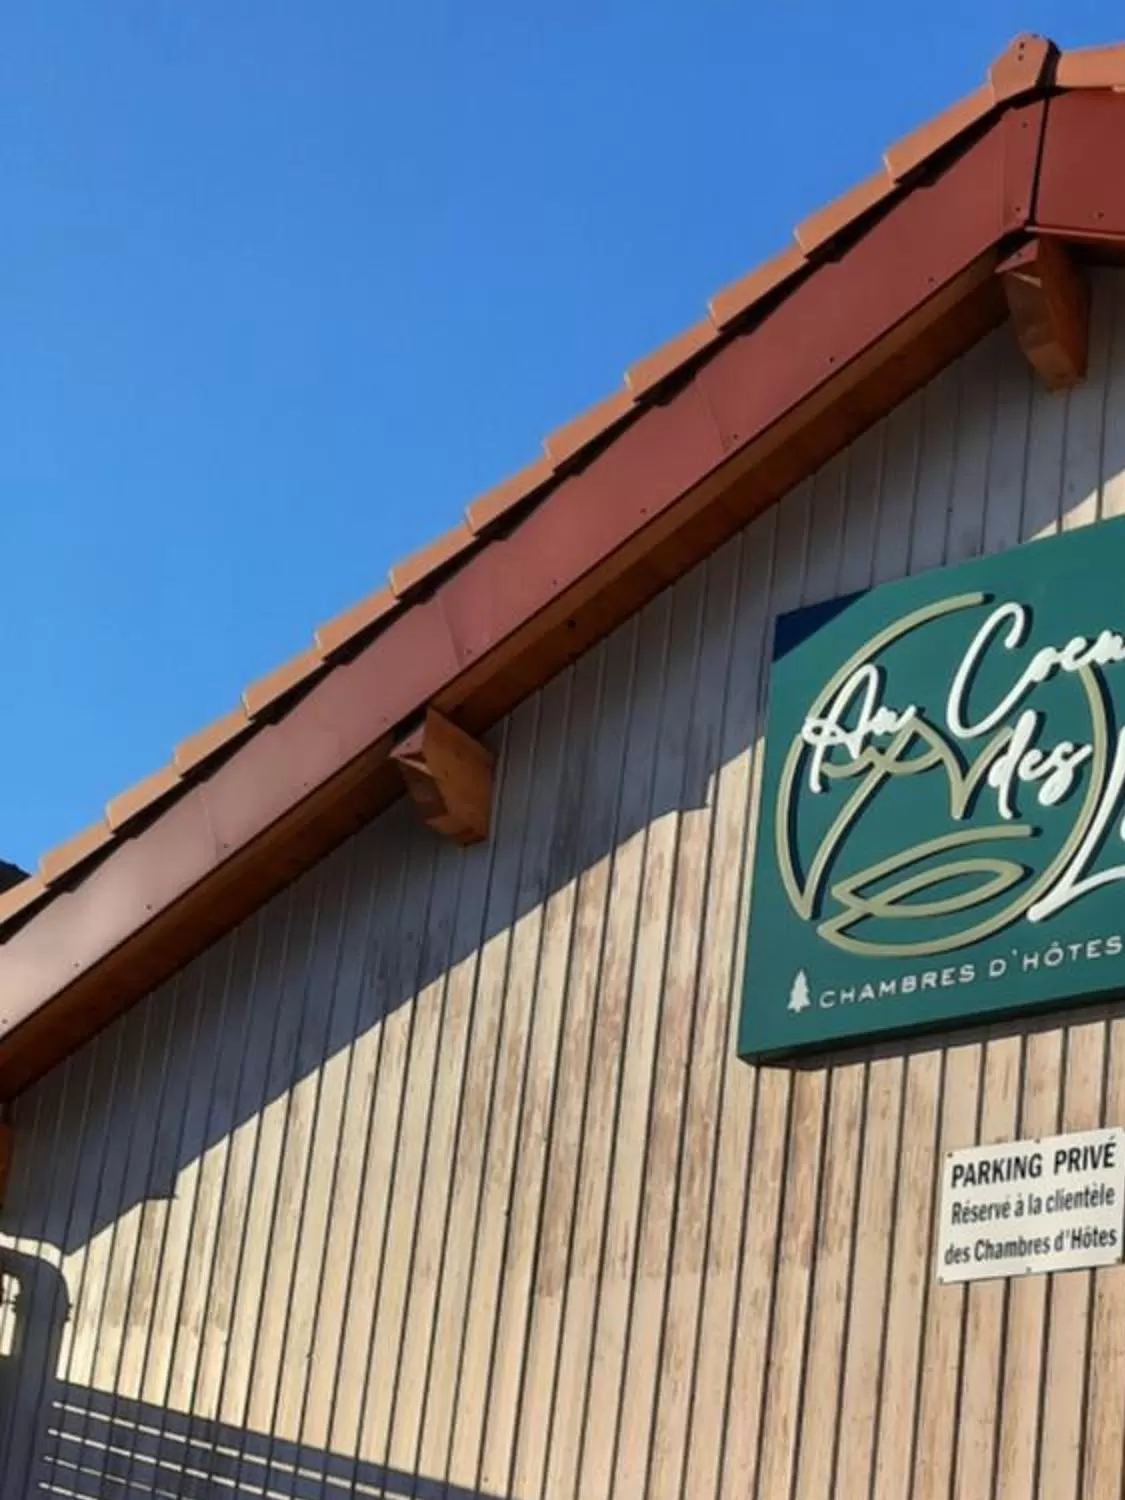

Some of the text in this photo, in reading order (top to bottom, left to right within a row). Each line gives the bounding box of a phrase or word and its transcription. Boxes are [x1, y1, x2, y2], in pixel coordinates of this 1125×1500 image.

[801, 663, 917, 793] Au
[987, 709, 1093, 819] des
[819, 963, 976, 1010] CHAMBRES
[988, 933, 1124, 978] D'HÔTES
[951, 1135, 1117, 1189] PARKING PRIVÉ
[951, 1194, 1011, 1225] Réservé
[1014, 1192, 1025, 1217] à
[1027, 1193, 1042, 1215] la
[944, 1225, 1118, 1265] des Chambres d'Hôtes
